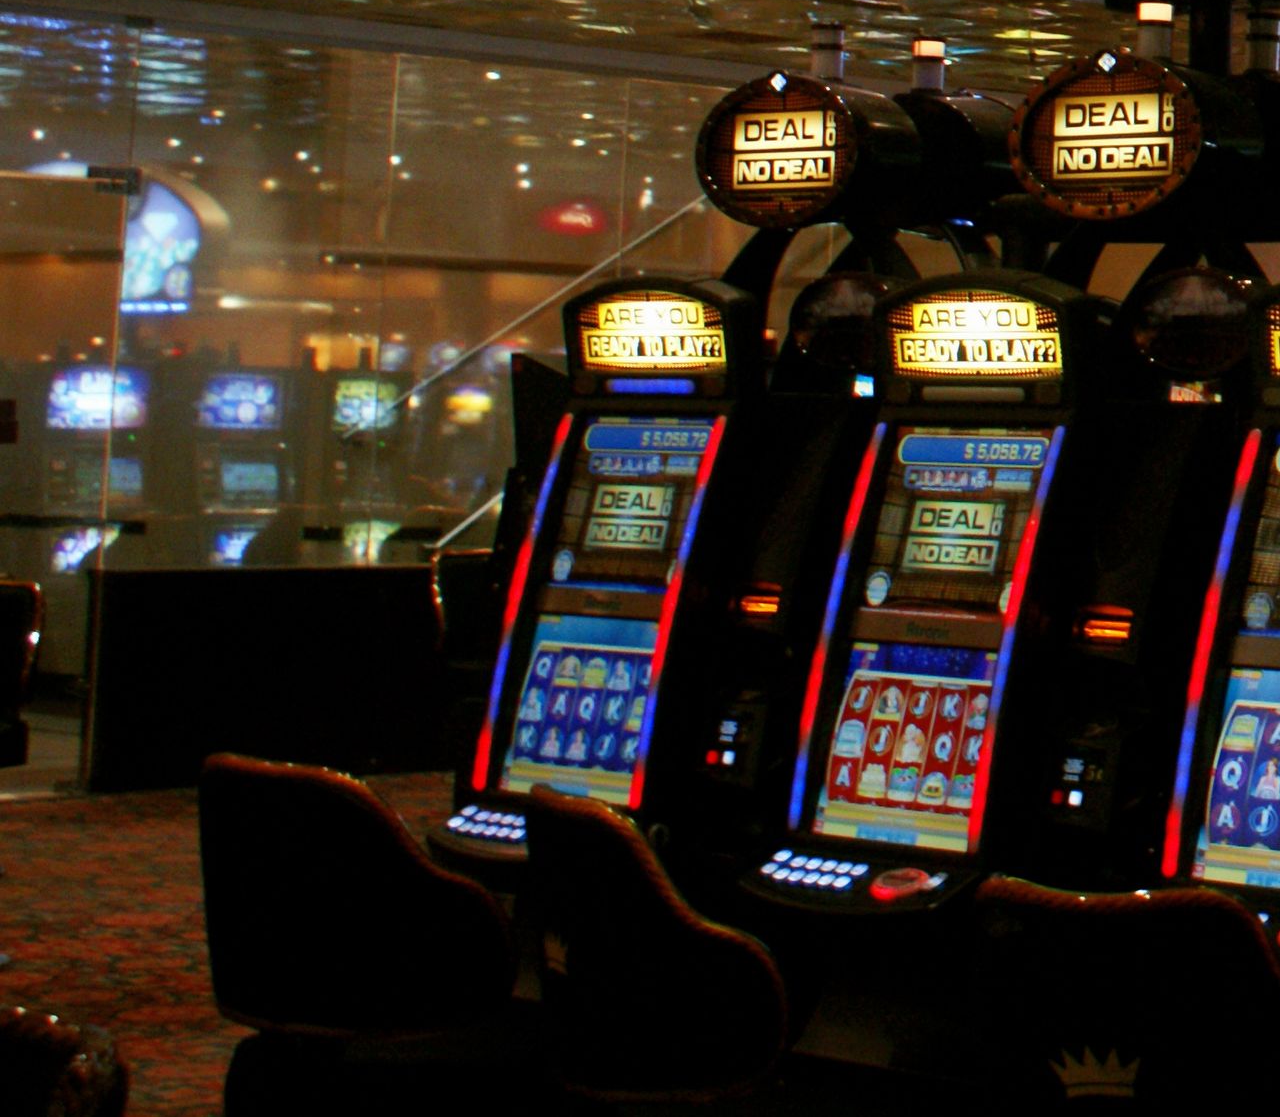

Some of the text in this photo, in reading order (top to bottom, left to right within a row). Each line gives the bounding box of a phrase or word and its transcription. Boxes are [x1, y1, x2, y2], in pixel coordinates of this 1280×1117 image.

[1065, 99, 1149, 129] DEAL
[1162, 92, 1175, 132] OR
[743, 116, 815, 145] DEAL
[824, 110, 836, 148] OR
[737, 155, 830, 183] NO DEAL
[1058, 144, 1168, 172] NO DEAL
[602, 308, 701, 326] ARE YOU
[918, 308, 1031, 329] ARE YOU
[589, 335, 722, 359] READY TO PLAY??
[902, 339, 1057, 363] READY TO PLAY??
[640, 430, 709, 449] $ 5,058.72
[964, 442, 1042, 462] $ 5,058.72
[600, 489, 657, 510] DEAL
[917, 508, 986, 531] DEAL
[591, 523, 664, 544] NO DEAL
[909, 543, 993, 566] NO DEAL
